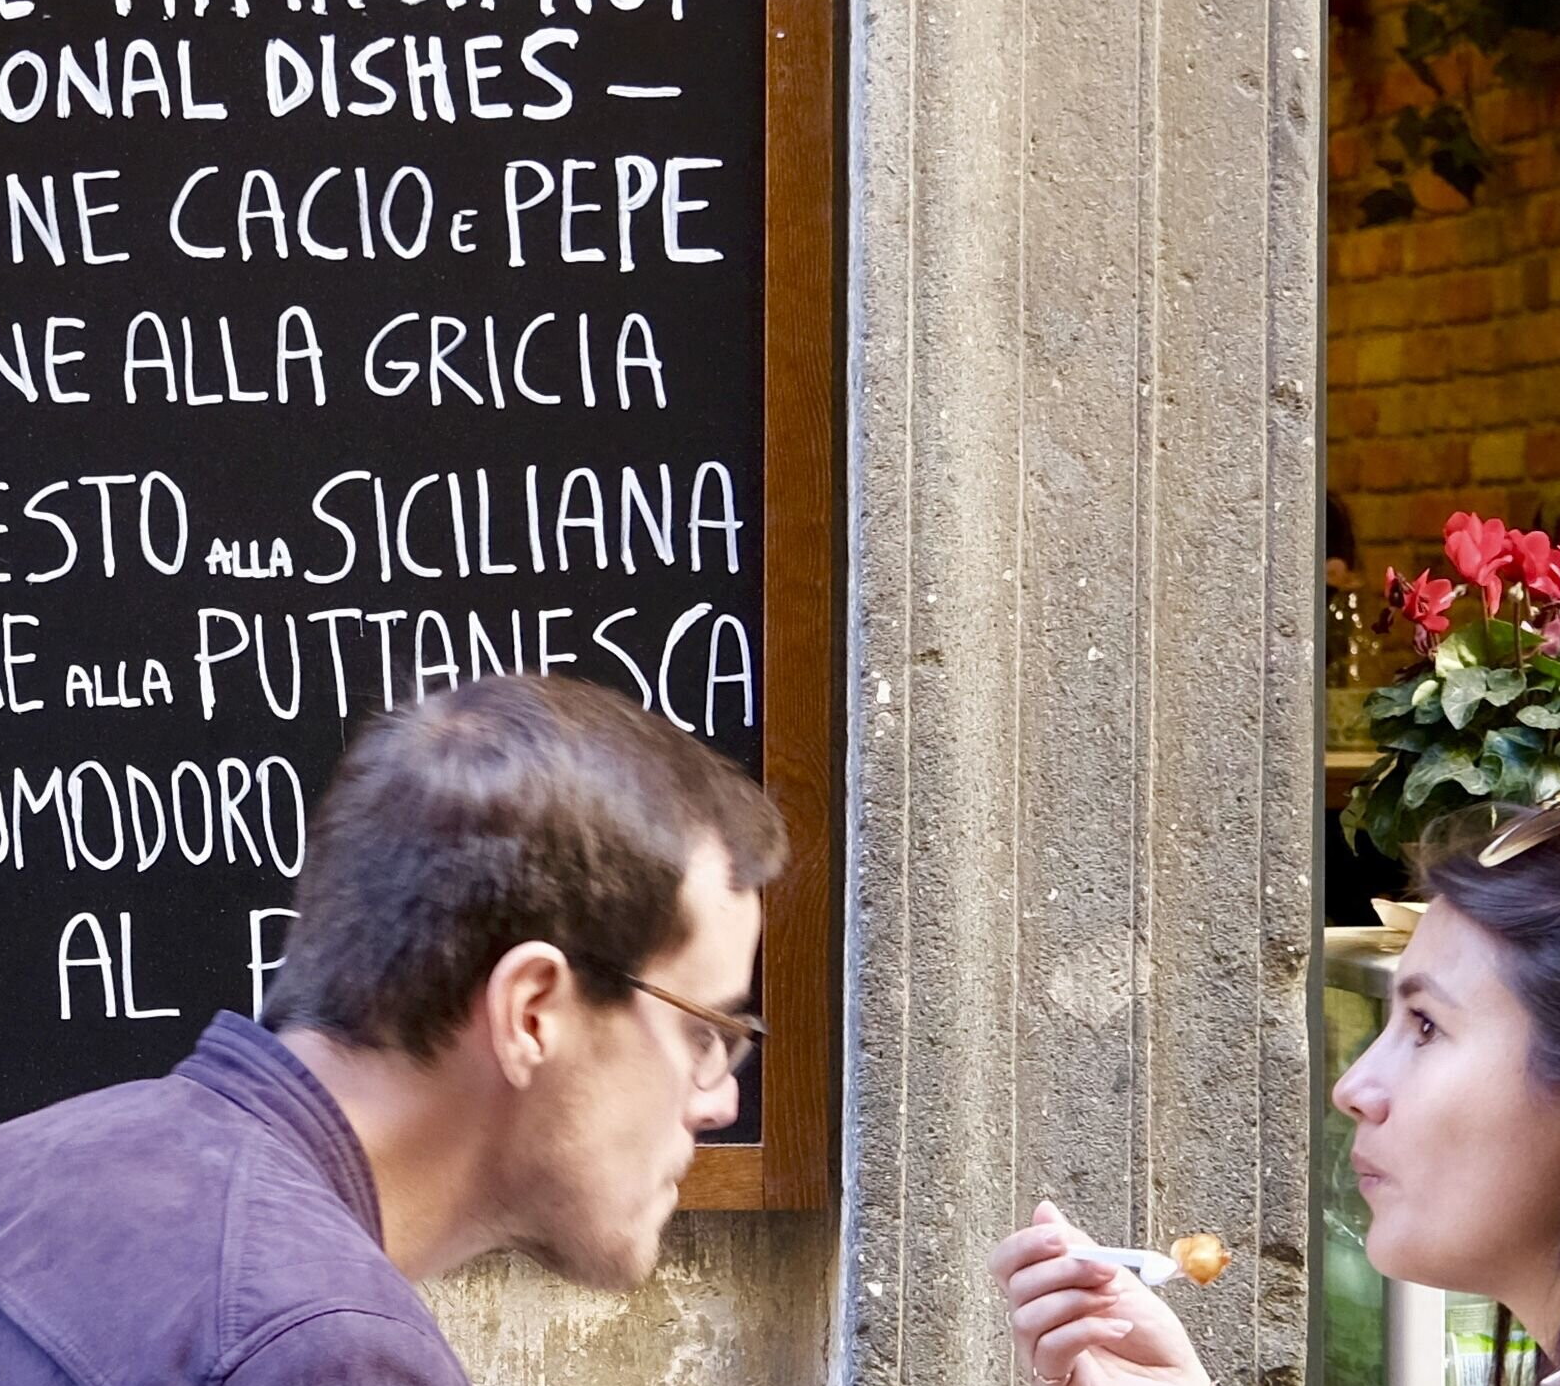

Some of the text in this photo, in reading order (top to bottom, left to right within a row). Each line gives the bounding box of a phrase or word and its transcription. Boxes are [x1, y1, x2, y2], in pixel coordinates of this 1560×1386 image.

[265, 27, 579, 123] DISHES
[169, 166, 433, 261] CACIO
[504, 155, 724, 272] PEPE
[124, 306, 326, 406] ALLA
[365, 312, 667, 410] GRICIA
[205, 537, 293, 578] ALLA
[304, 461, 743, 584] SICILIANA
[66, 659, 173, 708] ALLA
[193, 602, 754, 737] PUTTANESCA
[58, 912, 180, 1020] AL
